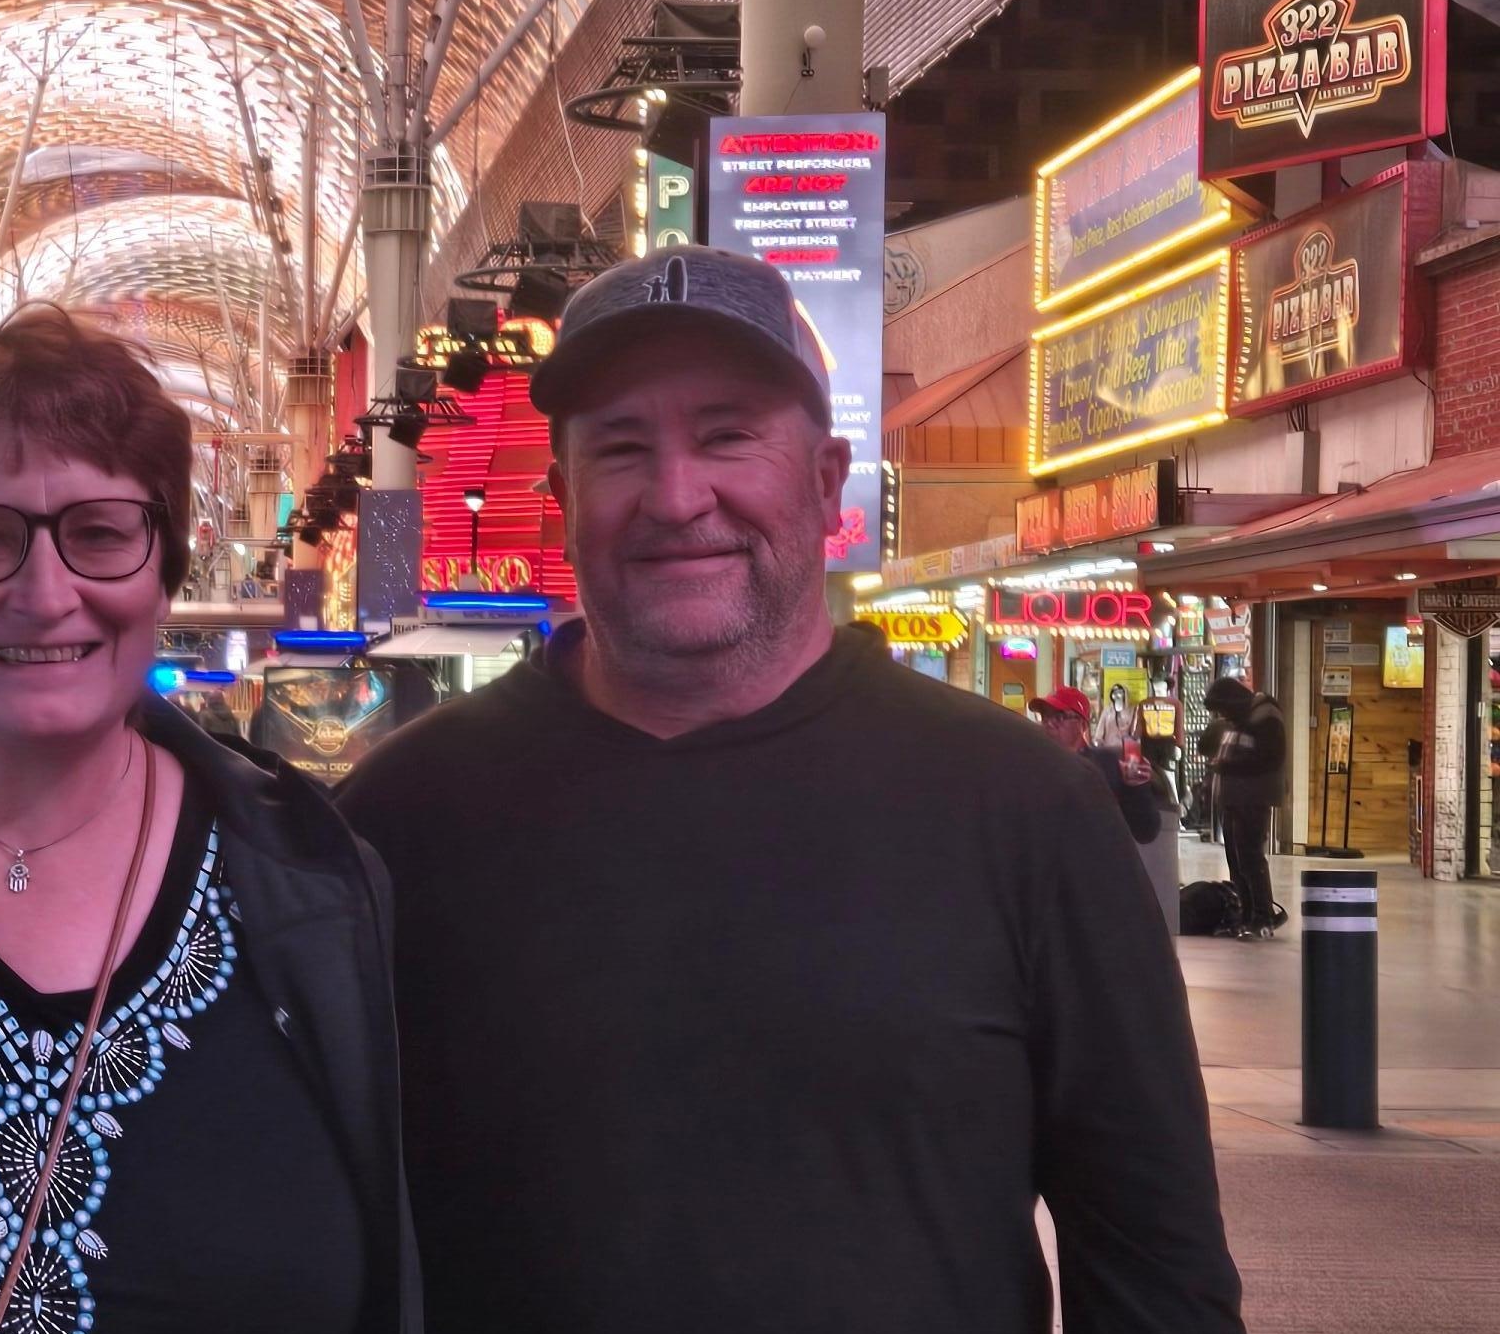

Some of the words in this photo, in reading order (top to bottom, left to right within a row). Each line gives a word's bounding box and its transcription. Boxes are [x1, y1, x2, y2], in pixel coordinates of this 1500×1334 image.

[1280, 0, 1338, 47] 322
[1222, 47, 1321, 105] PIZZA
[1329, 31, 1399, 83] BAR
[720, 131, 880, 154] ATTENTION!
[722, 160, 773, 172] STREET
[776, 157, 871, 170] PERFORMERS
[744, 175, 793, 194] ARE
[796, 174, 847, 193] NOT
[742, 200, 826, 213] EMPLOYEES
[828, 199, 850, 211] OF
[734, 218, 802, 230] FREMONT
[805, 217, 857, 229] STREET
[751, 235, 839, 247] EXPERIENCE
[793, 269, 861, 282] PAYMENT
[1272, 288, 1320, 341] PIZZA
[1320, 274, 1354, 323] BAR
[1122, 349, 1151, 387] Beer,
[1154, 332, 1188, 374] Wine
[422, 554, 532, 593] SINO
[994, 590, 1152, 627] LIQUOR
[880, 616, 943, 640] ACOS
[1107, 655, 1131, 665] ZYN
